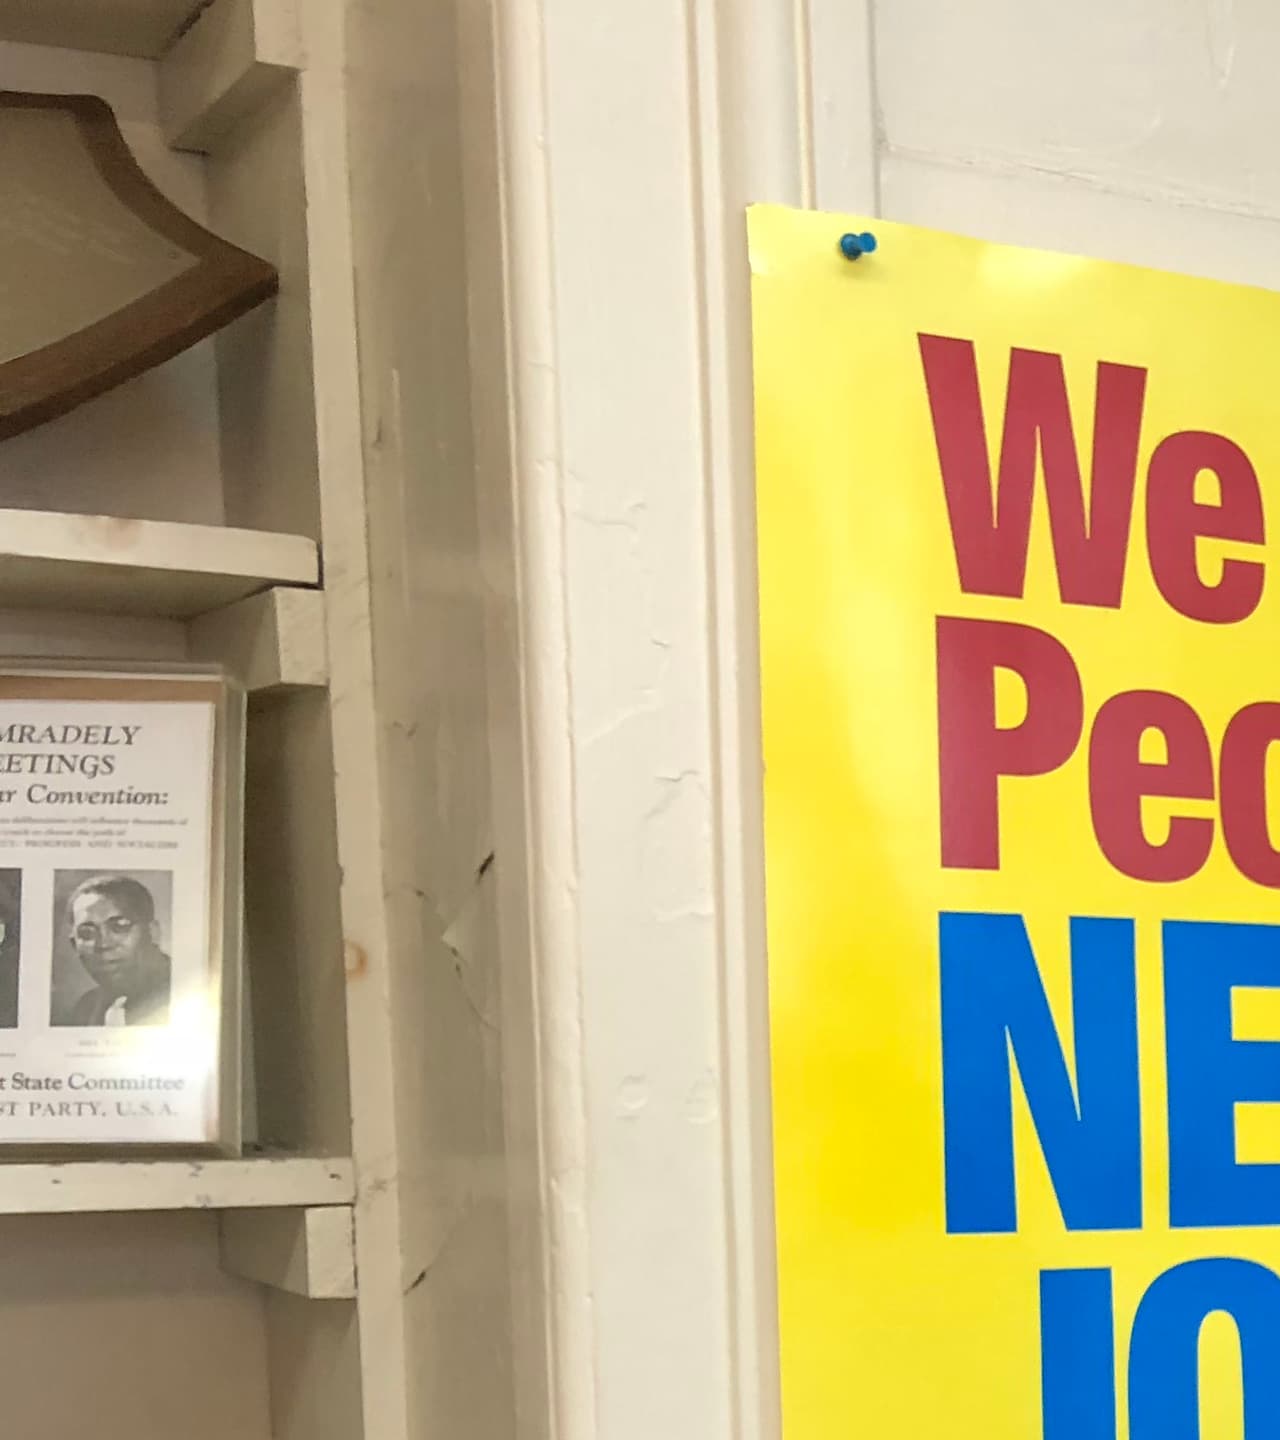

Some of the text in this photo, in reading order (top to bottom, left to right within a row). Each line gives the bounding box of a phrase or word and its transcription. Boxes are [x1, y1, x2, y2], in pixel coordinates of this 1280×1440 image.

[917, 332, 1266, 624] We
[27, 783, 169, 805] Convention:
[11, 1072, 62, 1090] State
[68, 1072, 185, 1091] Committee
[30, 1102, 107, 1118] PARTY,
